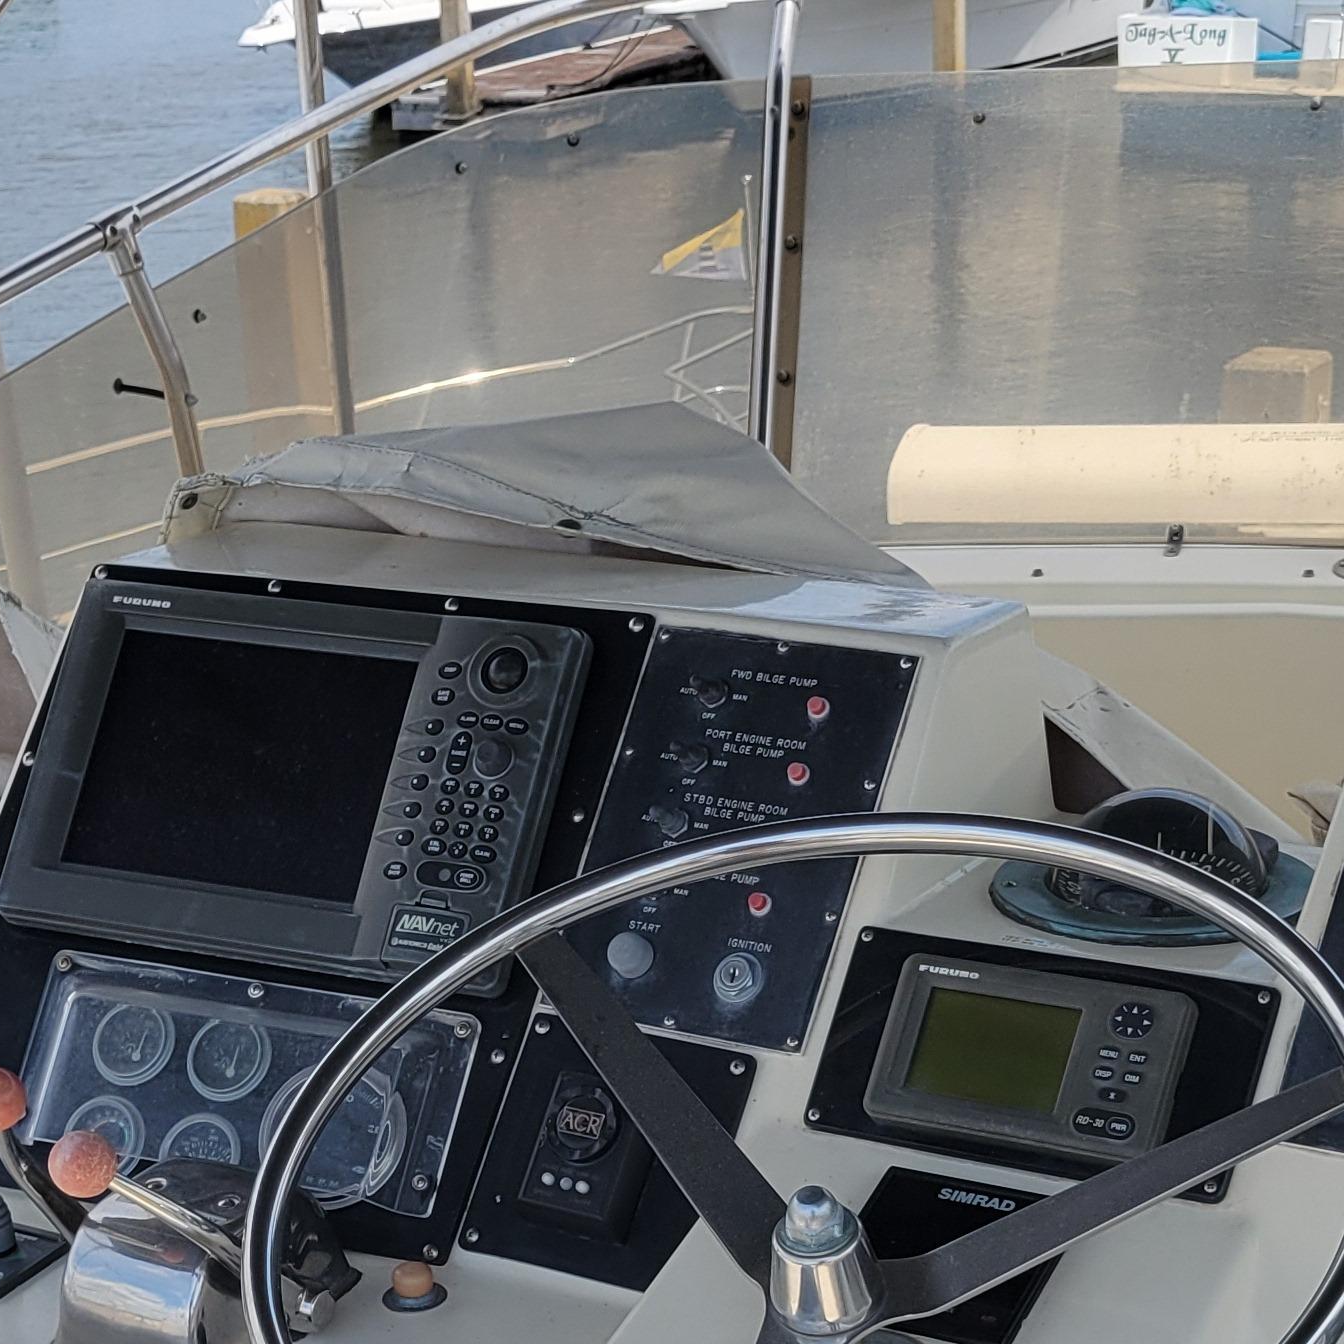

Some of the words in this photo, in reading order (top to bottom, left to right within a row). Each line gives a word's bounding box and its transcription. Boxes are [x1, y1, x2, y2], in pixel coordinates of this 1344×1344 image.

[112, 595, 172, 609] FURUNO
[731, 669, 752, 680] FWD
[756, 672, 785, 685] BILGE
[789, 677, 818, 688] PUMP
[680, 687, 698, 696] AUTO
[732, 694, 748, 702] MAN
[702, 712, 716, 720] OFF
[706, 728, 732, 740] PORT
[735, 733, 772, 746] ENGINE
[776, 738, 807, 751] ROOM
[660, 753, 679, 761] AUTO
[723, 743, 751, 755] BILGE
[755, 748, 785, 759] PUMP
[712, 759, 728, 767] MAN
[681, 778, 696, 786] OFF
[684, 793, 713, 805] STBD
[716, 797, 754, 811] ENGINE
[758, 803, 789, 816] ROOM
[641, 814, 658, 822] AUT
[704, 806, 733, 819] BILGE
[737, 811, 766, 823] PUMP
[693, 822, 709, 830] MAN
[731, 873, 760, 886] PUMP
[673, 888, 689, 896] MAN
[643, 906, 656, 914] OFF
[395, 914, 459, 937] NAVnet
[628, 920, 661, 933] START
[728, 937, 772, 952] IGNITION
[919, 964, 979, 979] FURUNO
[1100, 1049, 1118, 1058] MENU
[1129, 1054, 1146, 1062] ENT
[1095, 1069, 1112, 1077] DISP
[561, 1115, 600, 1135] ACR
[1076, 1115, 1104, 1127] RD-30
[938, 1188, 1016, 1211] SIMRAD
